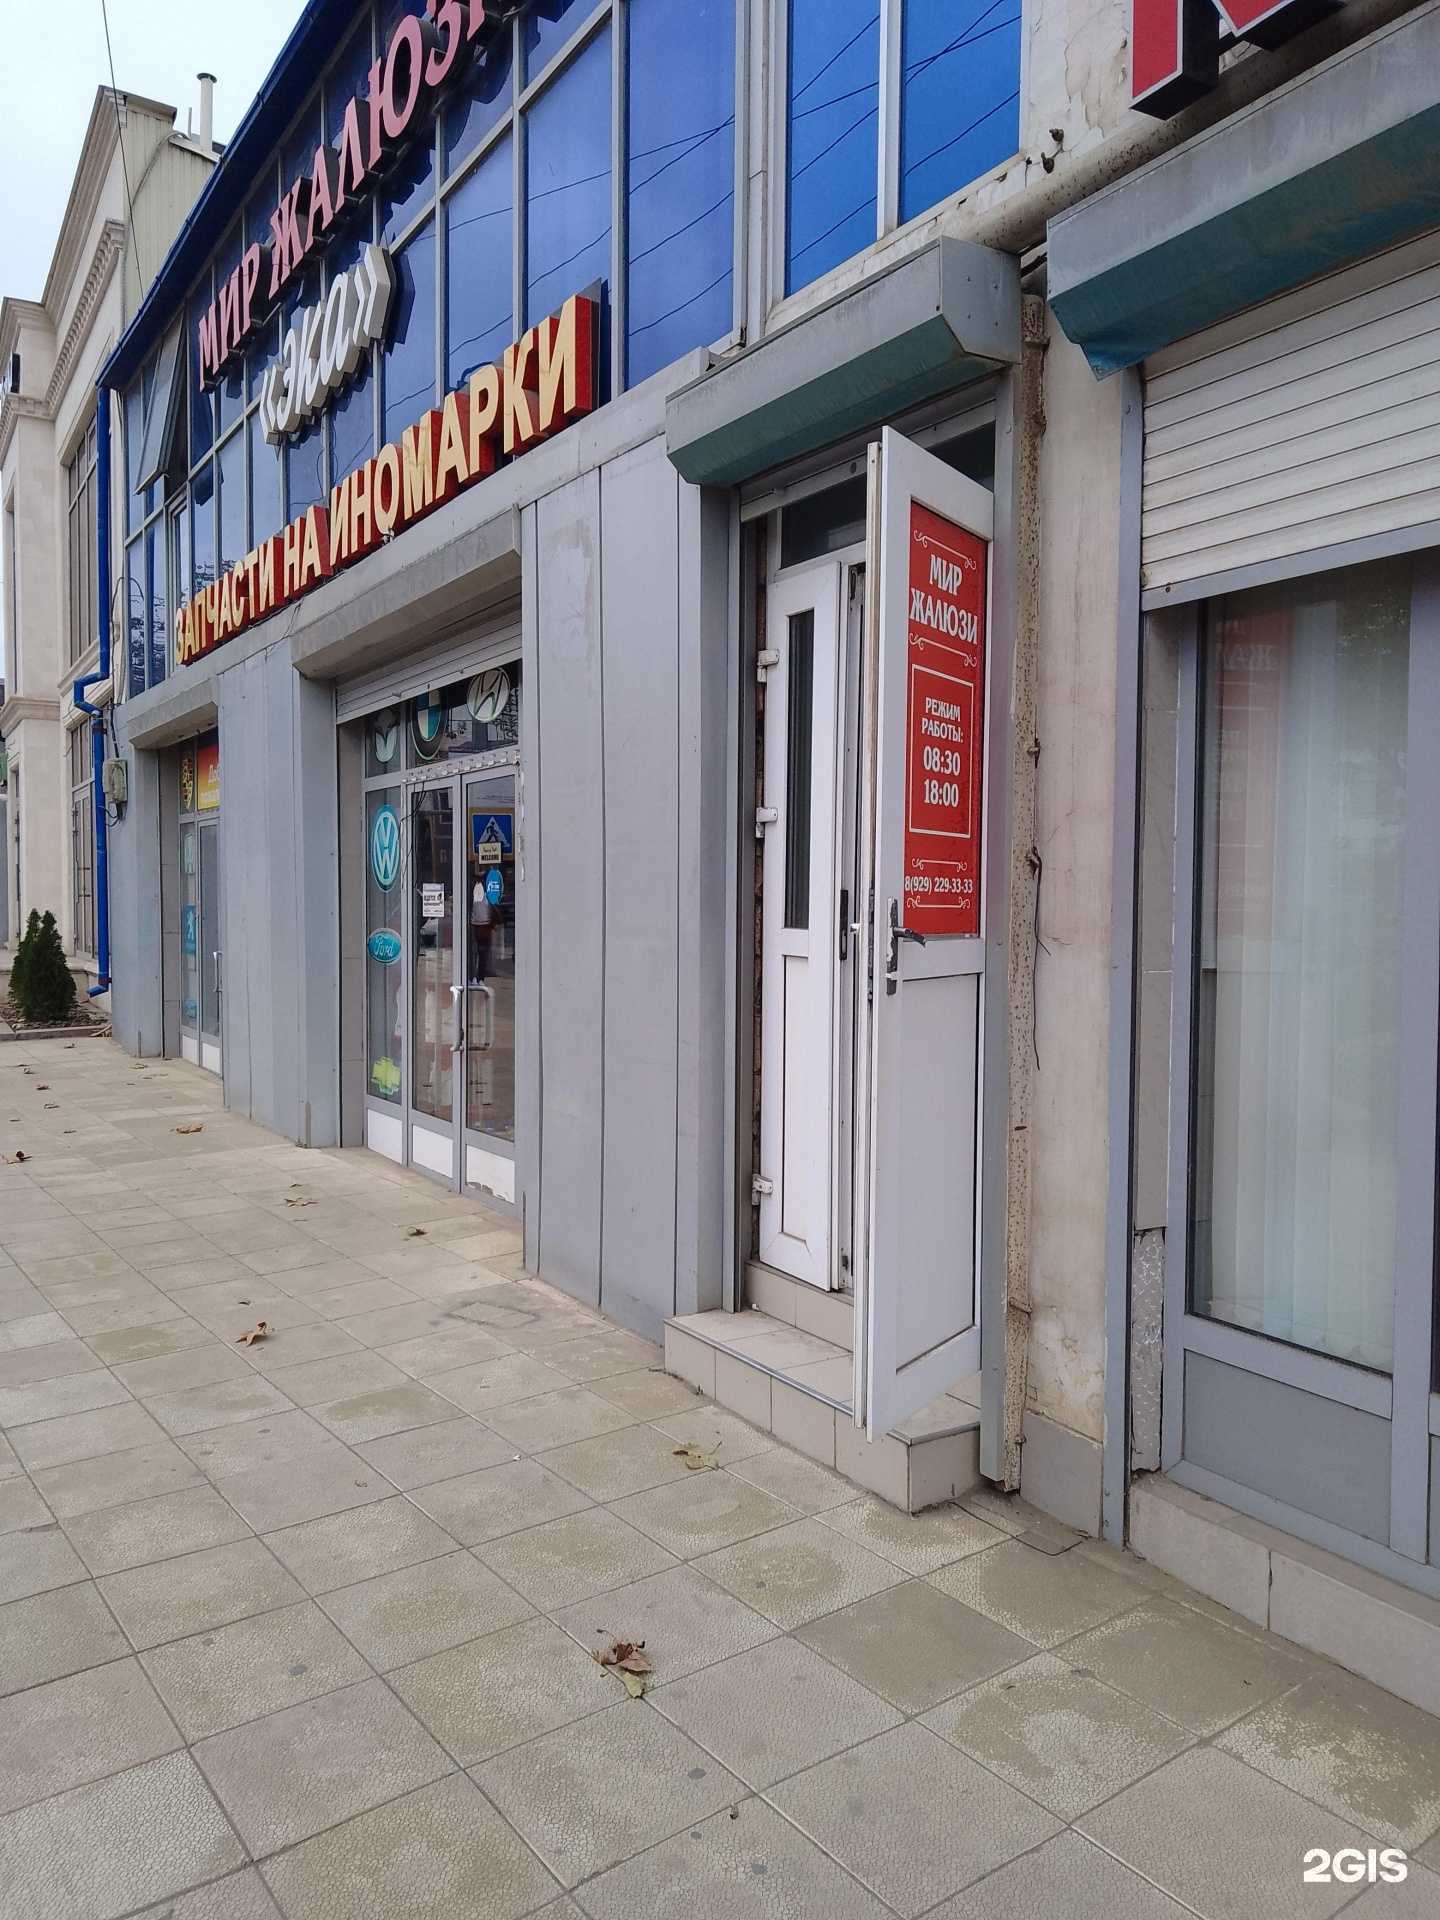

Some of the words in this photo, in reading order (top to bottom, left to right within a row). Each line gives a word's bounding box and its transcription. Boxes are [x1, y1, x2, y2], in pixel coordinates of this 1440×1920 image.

[199, 242, 261, 392] МИР
[269, 0, 485, 300] ЖАЛЮЗ
[176, 536, 275, 665] ЗАПЧАСТИ
[284, 505, 323, 599] НА
[330, 294, 578, 566] ИНОМАРКИ
[929, 553, 963, 597] МИР
[909, 586, 978, 645] ЖАЛЮЗИ
[925, 696, 961, 722] РЕЖИМ
[921, 717, 964, 743] РАБОТЫ:
[923, 745, 961, 776] 08:30
[924, 778, 959, 808] 18:00
[904, 875, 932, 895] 8(929)
[934, 877, 973, 894] 229-33-33
